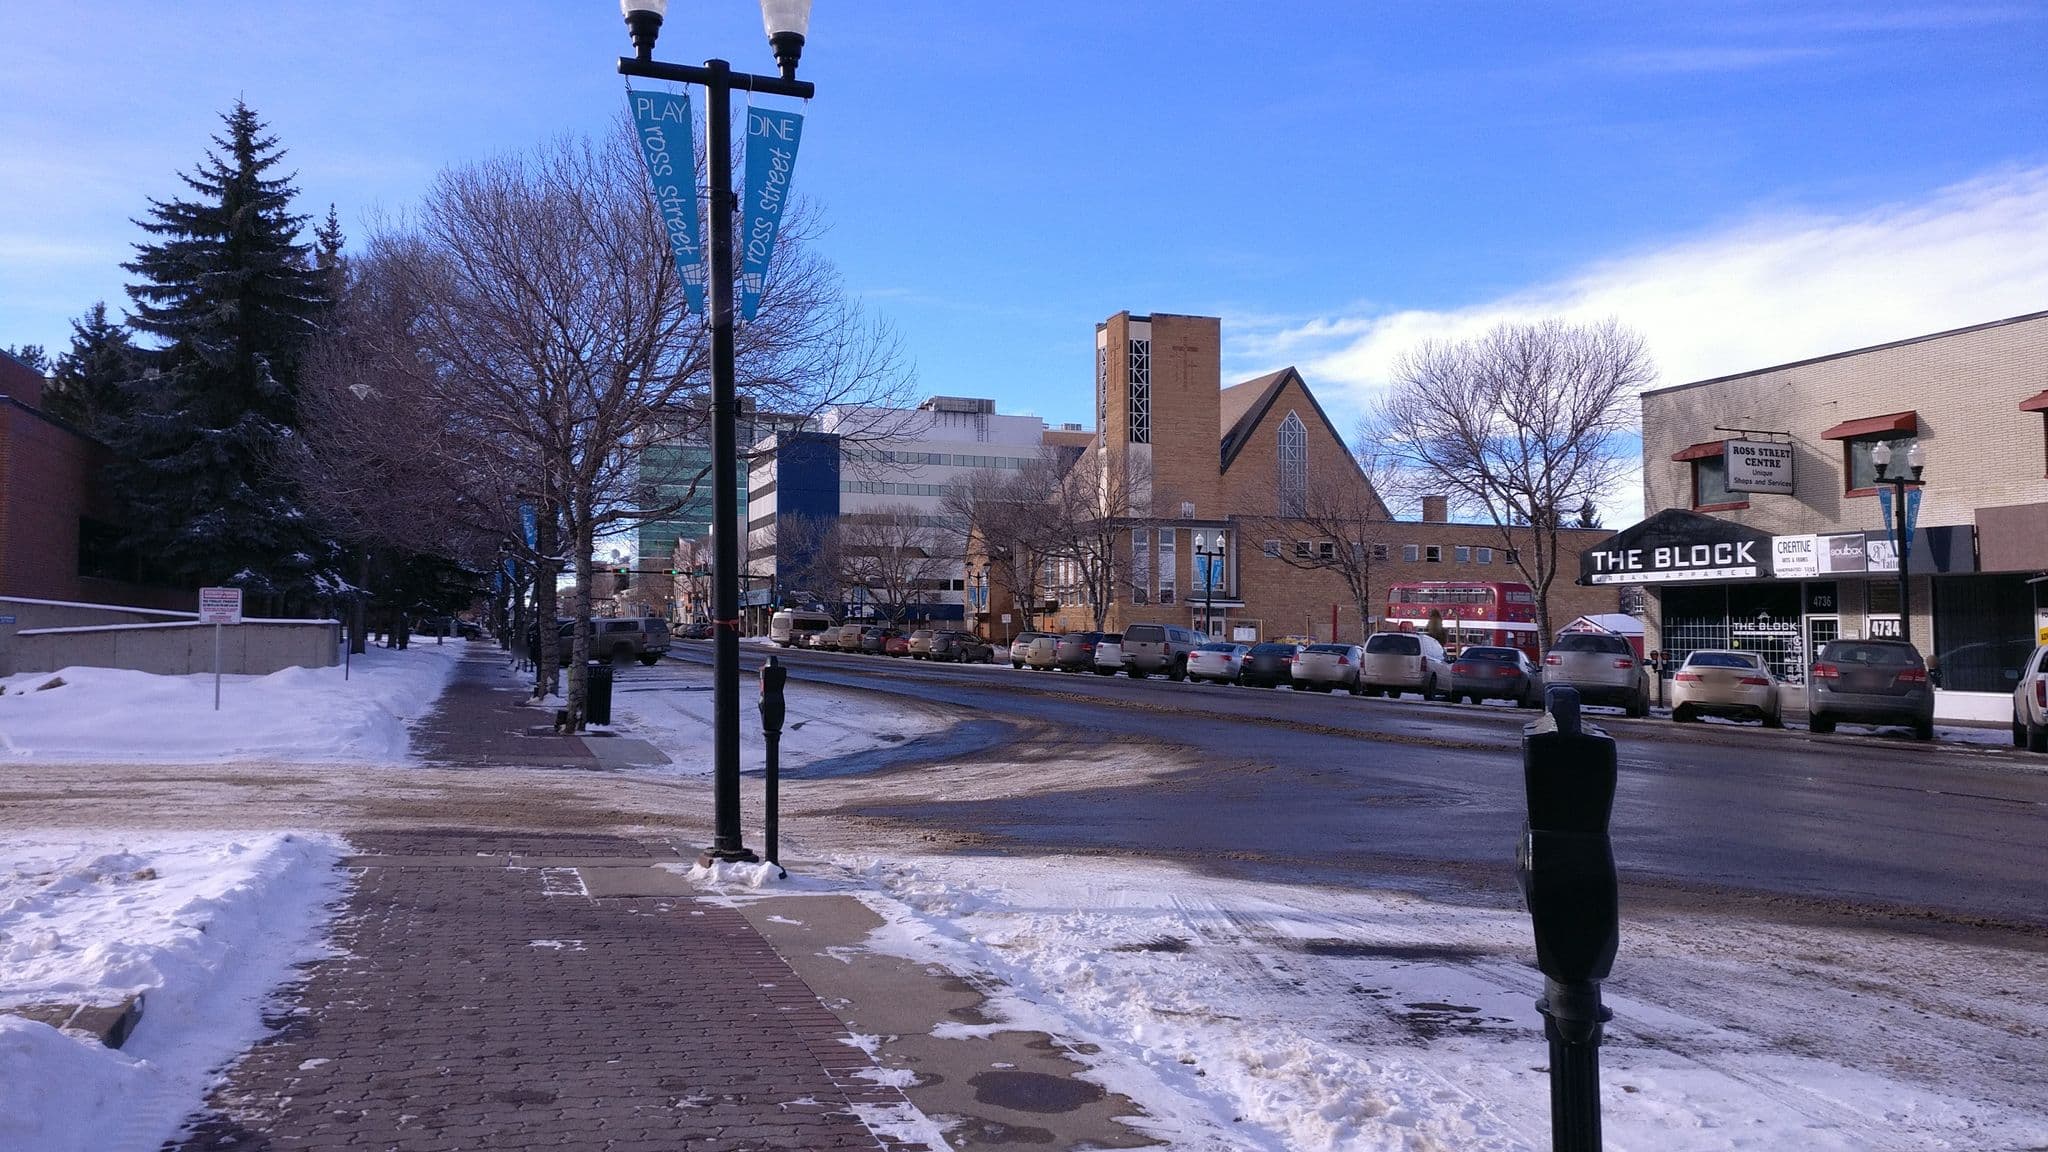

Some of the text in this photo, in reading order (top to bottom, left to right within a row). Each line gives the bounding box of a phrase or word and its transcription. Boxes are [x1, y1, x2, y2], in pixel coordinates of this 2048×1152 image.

[637, 97, 688, 123] PLAY
[748, 114, 794, 142] DINE
[644, 126, 698, 256] ross street
[747, 147, 792, 265] ross street
[1733, 446, 1791, 458] ROSS STREET
[1745, 457, 1781, 468] CENTRE
[1777, 540, 1812, 554] CREATIVE
[1830, 542, 1863, 556] soulbox
[1591, 540, 1757, 571] THE BLOCK
[1596, 570, 1750, 583] URBAN APPAREL
[1813, 596, 1832, 607] 4736
[1733, 622, 1798, 631] THE BLOCK
[1871, 620, 1900, 636] 4734
